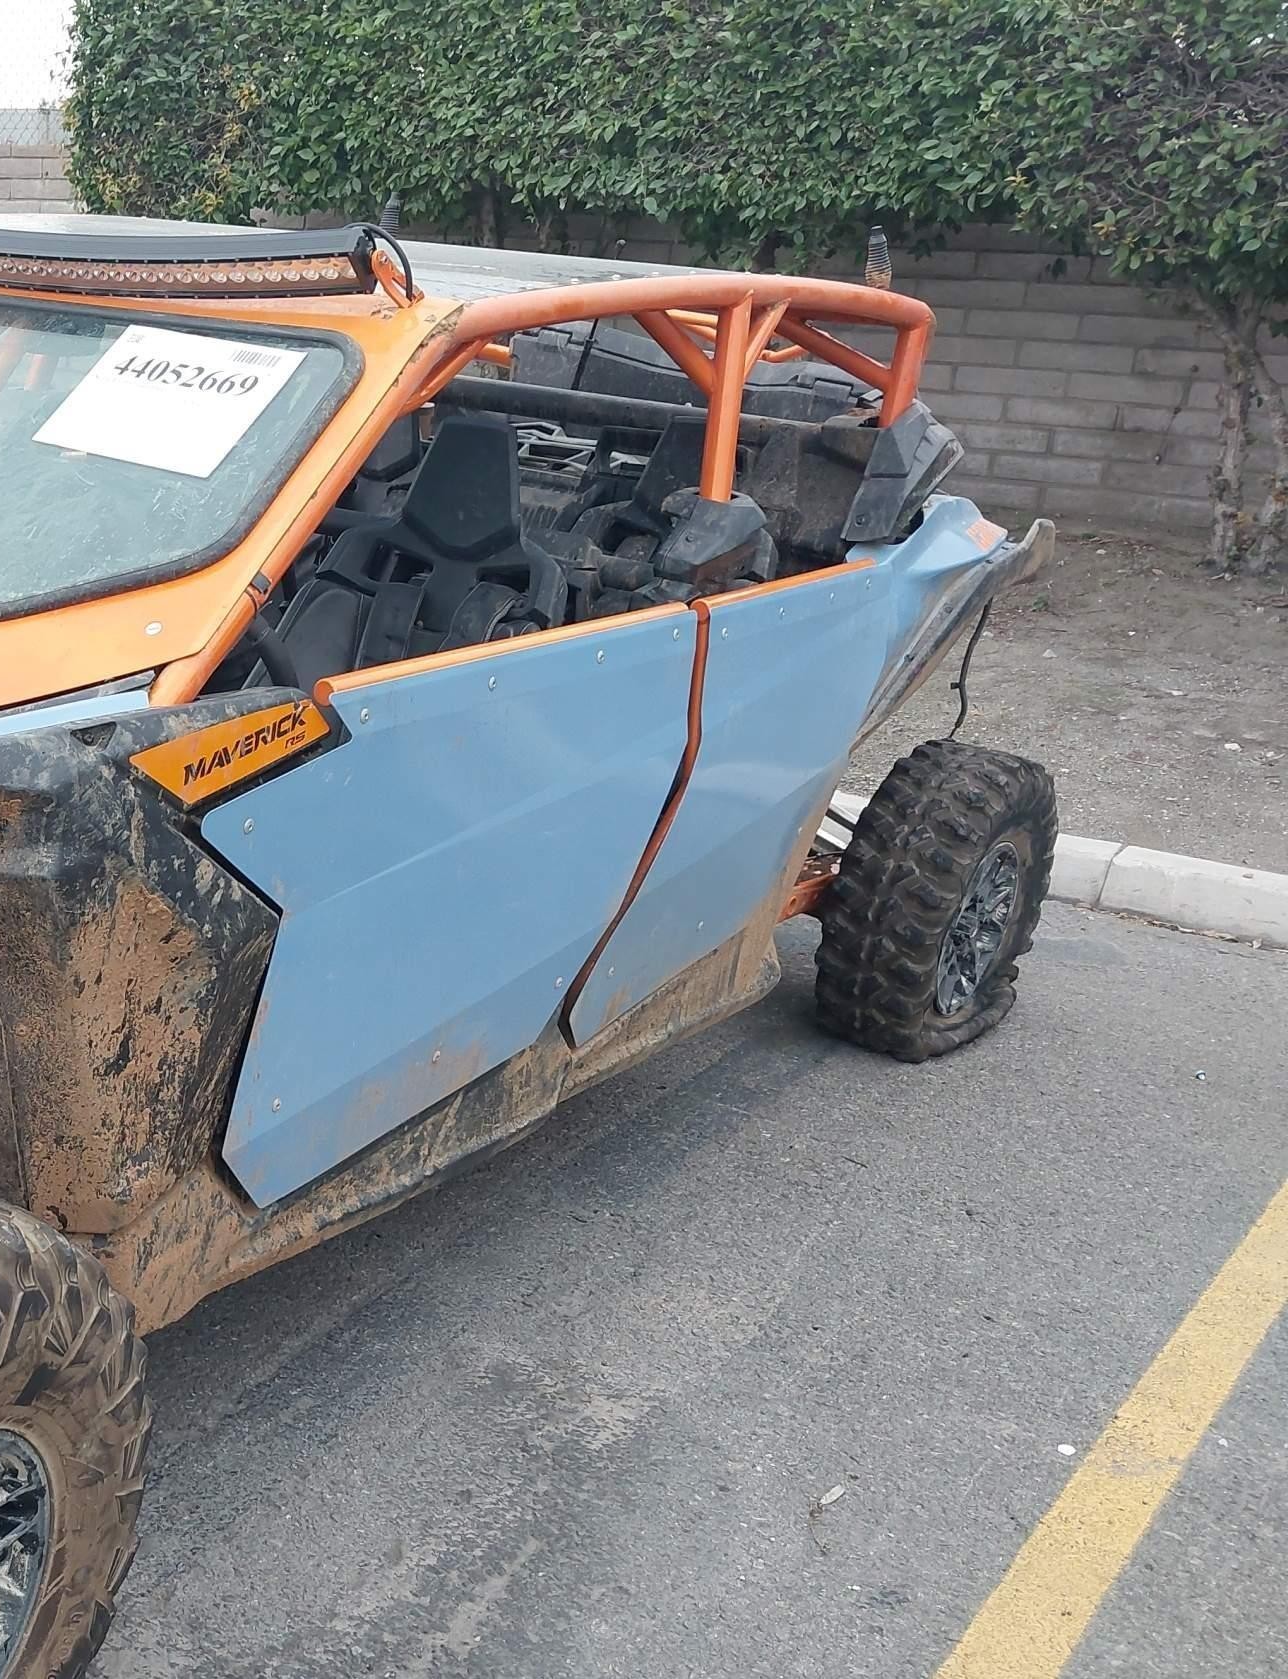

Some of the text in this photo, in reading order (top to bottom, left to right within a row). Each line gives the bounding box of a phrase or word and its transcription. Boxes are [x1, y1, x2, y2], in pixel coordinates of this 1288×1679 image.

[114, 355, 260, 397] 44052669
[183, 702, 309, 786] MAVERICK
[284, 730, 306, 750] RS
